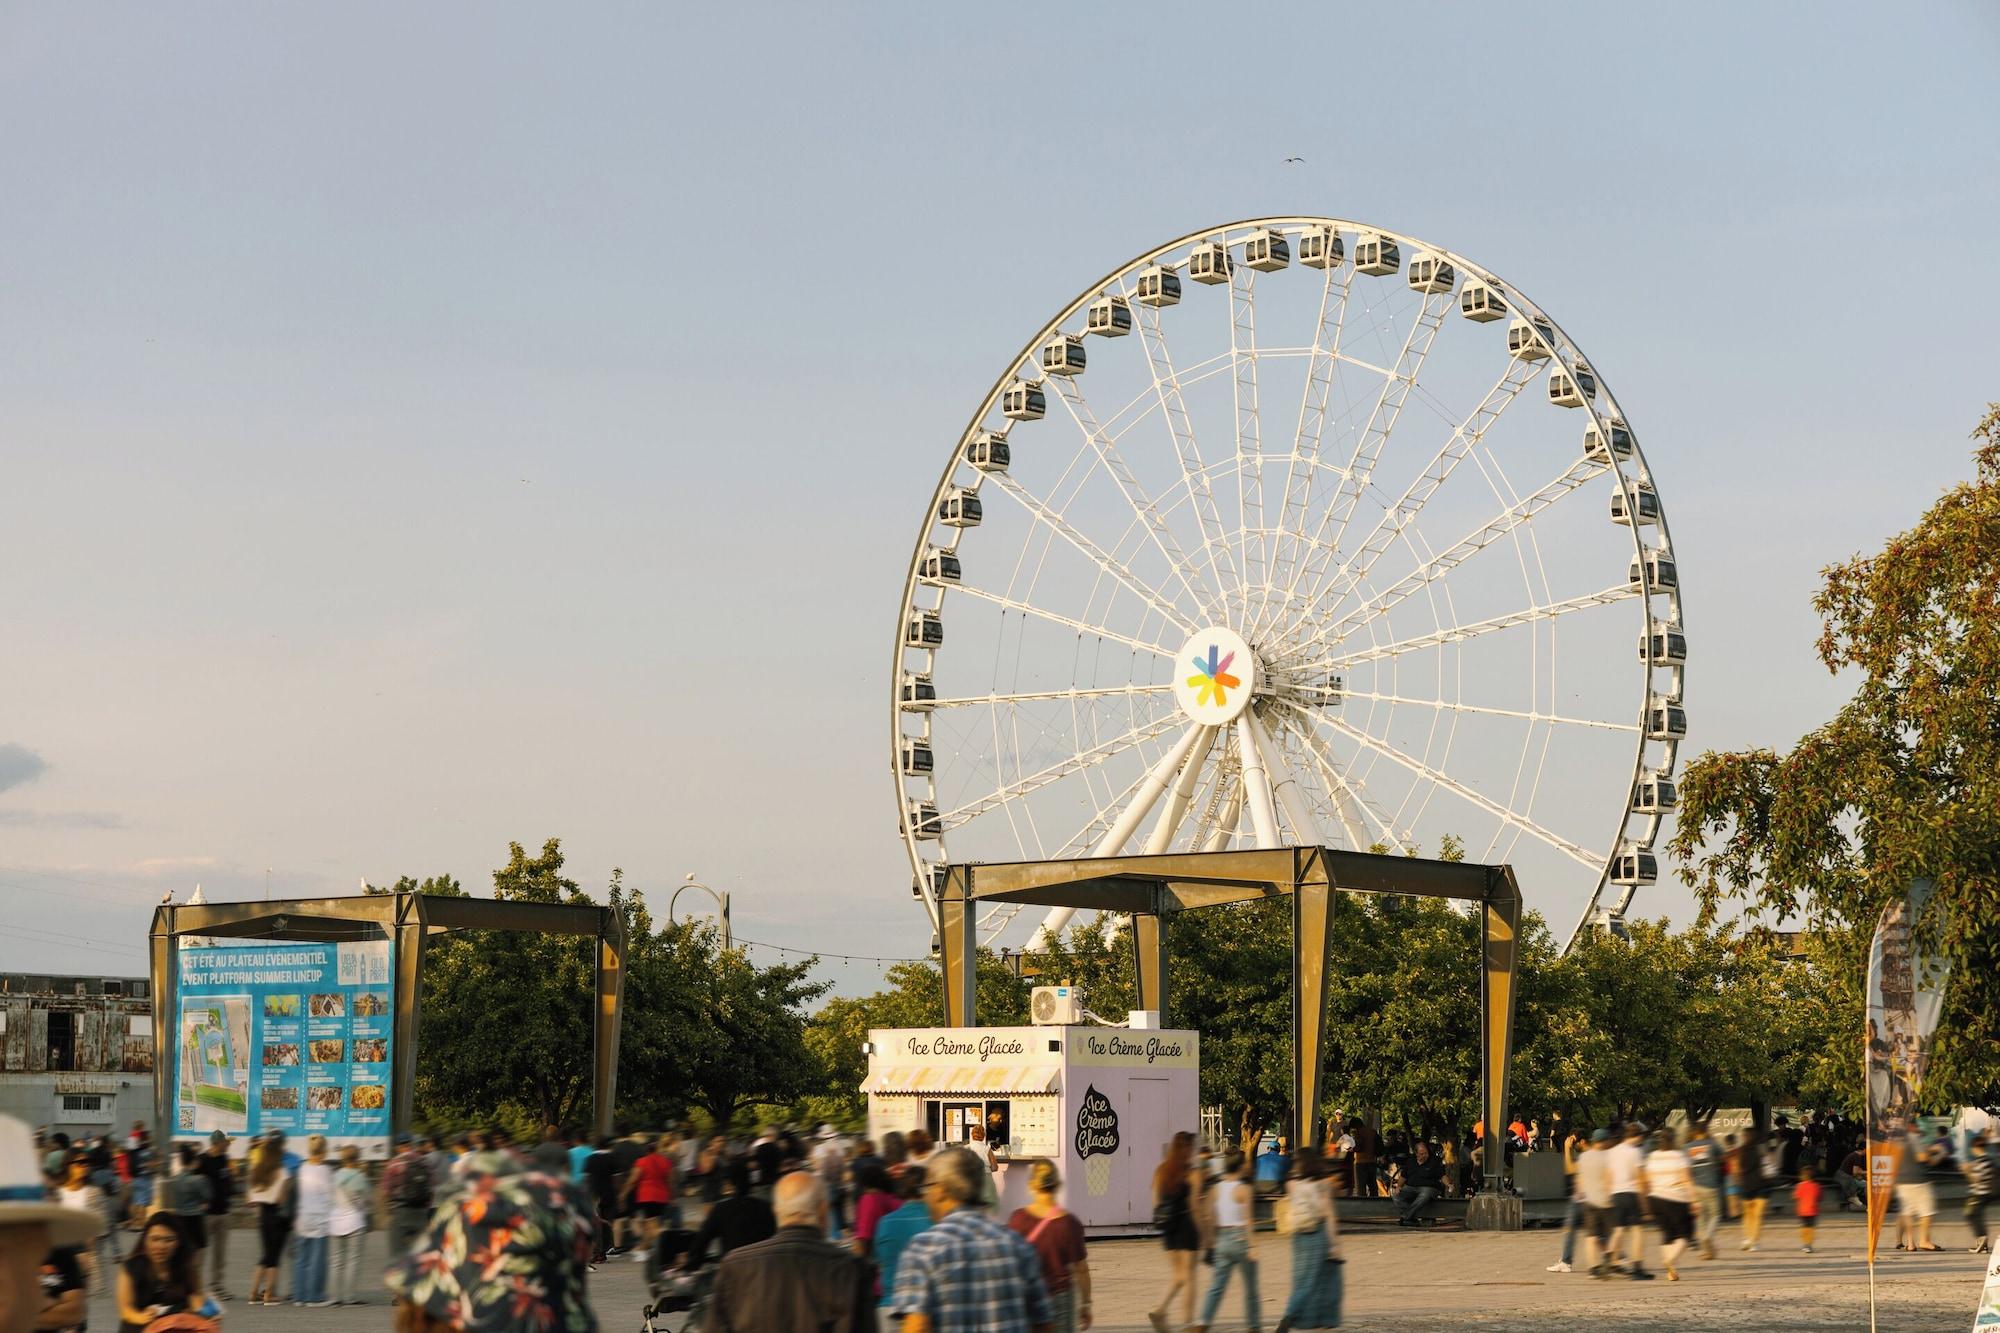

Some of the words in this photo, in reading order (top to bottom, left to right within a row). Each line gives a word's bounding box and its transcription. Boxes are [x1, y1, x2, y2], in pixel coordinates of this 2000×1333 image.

[182, 955, 198, 969] CET
[199, 952, 215, 968] ÉTÉ
[215, 954, 227, 968] AU
[227, 953, 264, 967] PLATEAU
[265, 950, 328, 966] ÉVÉNEMENTIEL
[182, 972, 209, 986] EVENT
[209, 971, 253, 985] PLATFORM
[254, 970, 293, 984] SUMMER
[293, 969, 323, 983] LINEUP
[907, 1037, 930, 1055] Ice
[933, 1036, 975, 1055] Crème
[978, 1036, 1024, 1062] Glacée
[1088, 1036, 1107, 1055] Ice
[1109, 1036, 1144, 1056] Crème
[1146, 1037, 1183, 1064] Glacée
[1086, 1095, 1108, 1112] Ice
[1079, 1108, 1116, 1130] Crème
[1723, 1118, 1737, 1127] DU
[1077, 1128, 1117, 1157] Glacée
